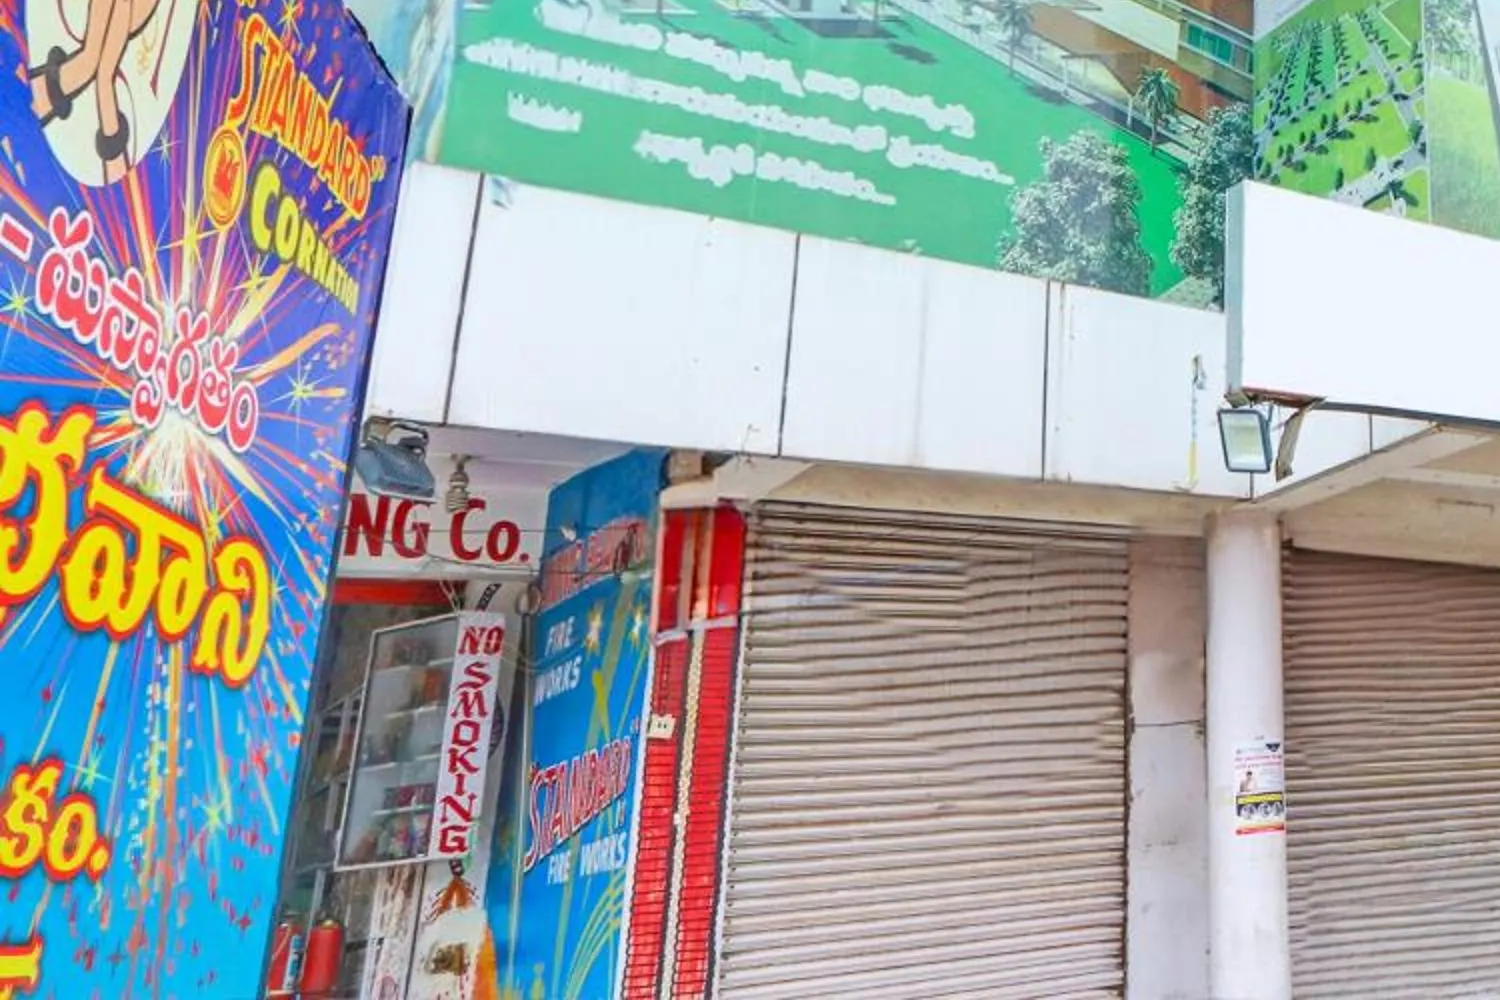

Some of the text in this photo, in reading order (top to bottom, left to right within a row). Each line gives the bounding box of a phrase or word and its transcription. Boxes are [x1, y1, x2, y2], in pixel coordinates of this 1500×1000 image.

[449, 497, 531, 564] Co.
[457, 626, 505, 657] NO
[545, 616, 576, 657] FIRE
[534, 655, 583, 707] WORKS
[438, 661, 494, 856] SMOKING
[547, 830, 629, 886] FIRE WORKS
